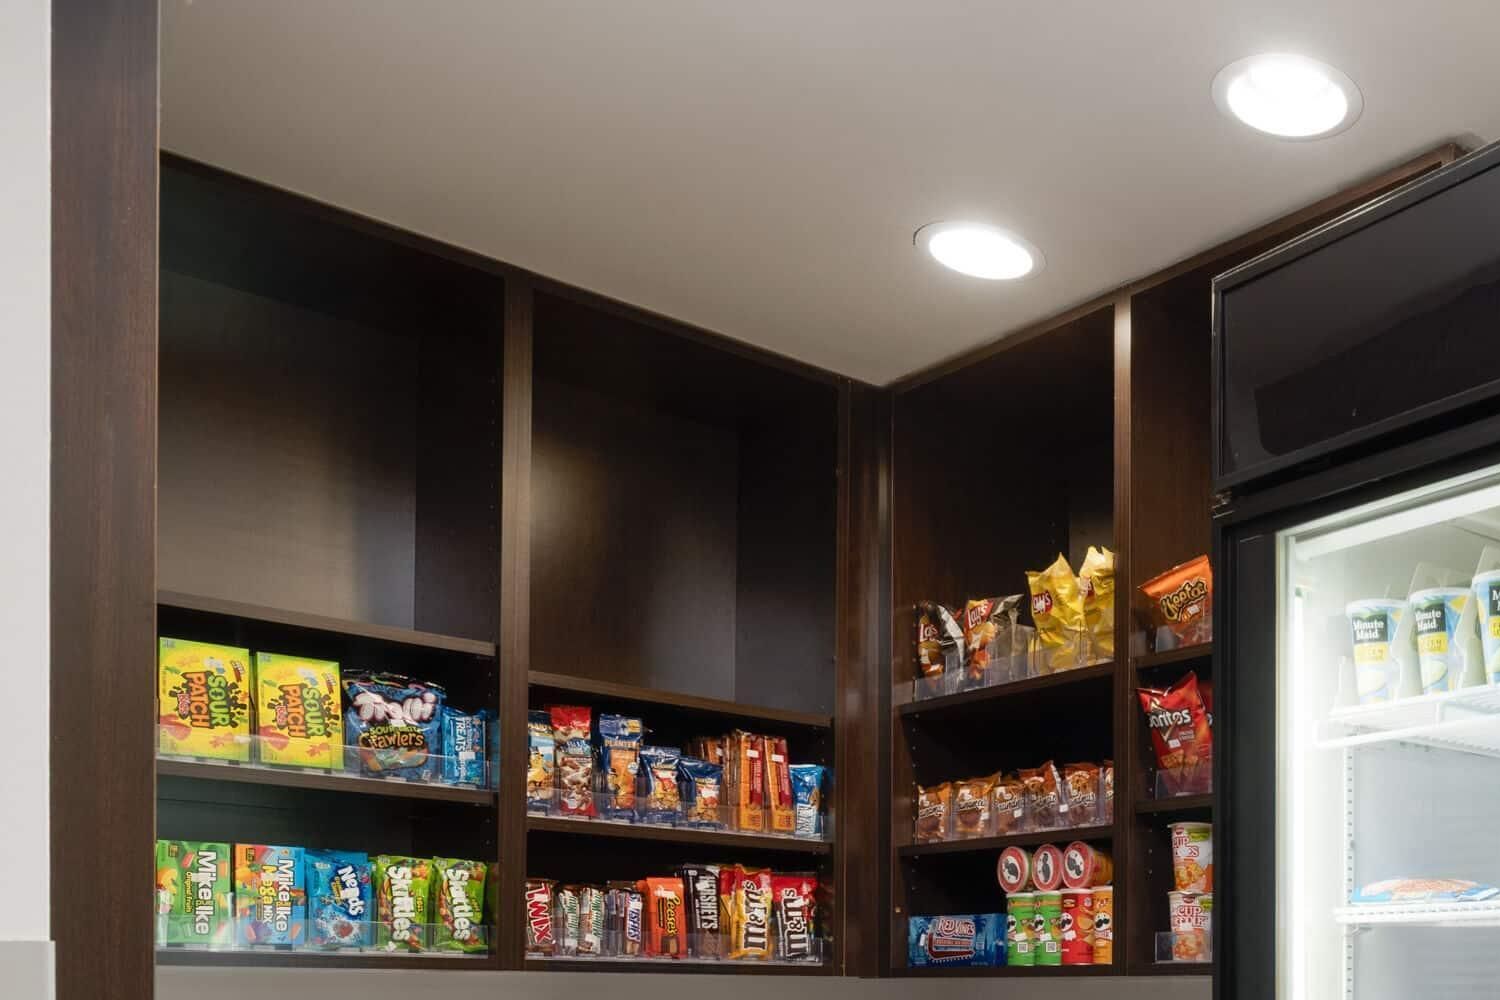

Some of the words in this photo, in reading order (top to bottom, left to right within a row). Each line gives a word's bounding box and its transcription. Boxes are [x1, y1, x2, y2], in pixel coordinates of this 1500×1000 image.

[1353, 619, 1384, 631] Minute
[1356, 629, 1380, 641] Maid
[184, 672, 211, 729] PATCH
[207, 675, 232, 727] SOUR
[280, 685, 308, 738] PATCH
[302, 687, 326, 737] SOUR
[455, 717, 466, 752] TREATS
[198, 851, 216, 900] Mike
[278, 858, 295, 902] Mike
[337, 865, 365, 916] Neds
[195, 905, 214, 935] Ike
[275, 906, 292, 932] Ike
[387, 865, 416, 941] Skittles
[446, 868, 475, 941] Skittles
[526, 883, 553, 944] TWIX
[666, 893, 681, 935] Reese's
[1178, 906, 1202, 917] CUP
